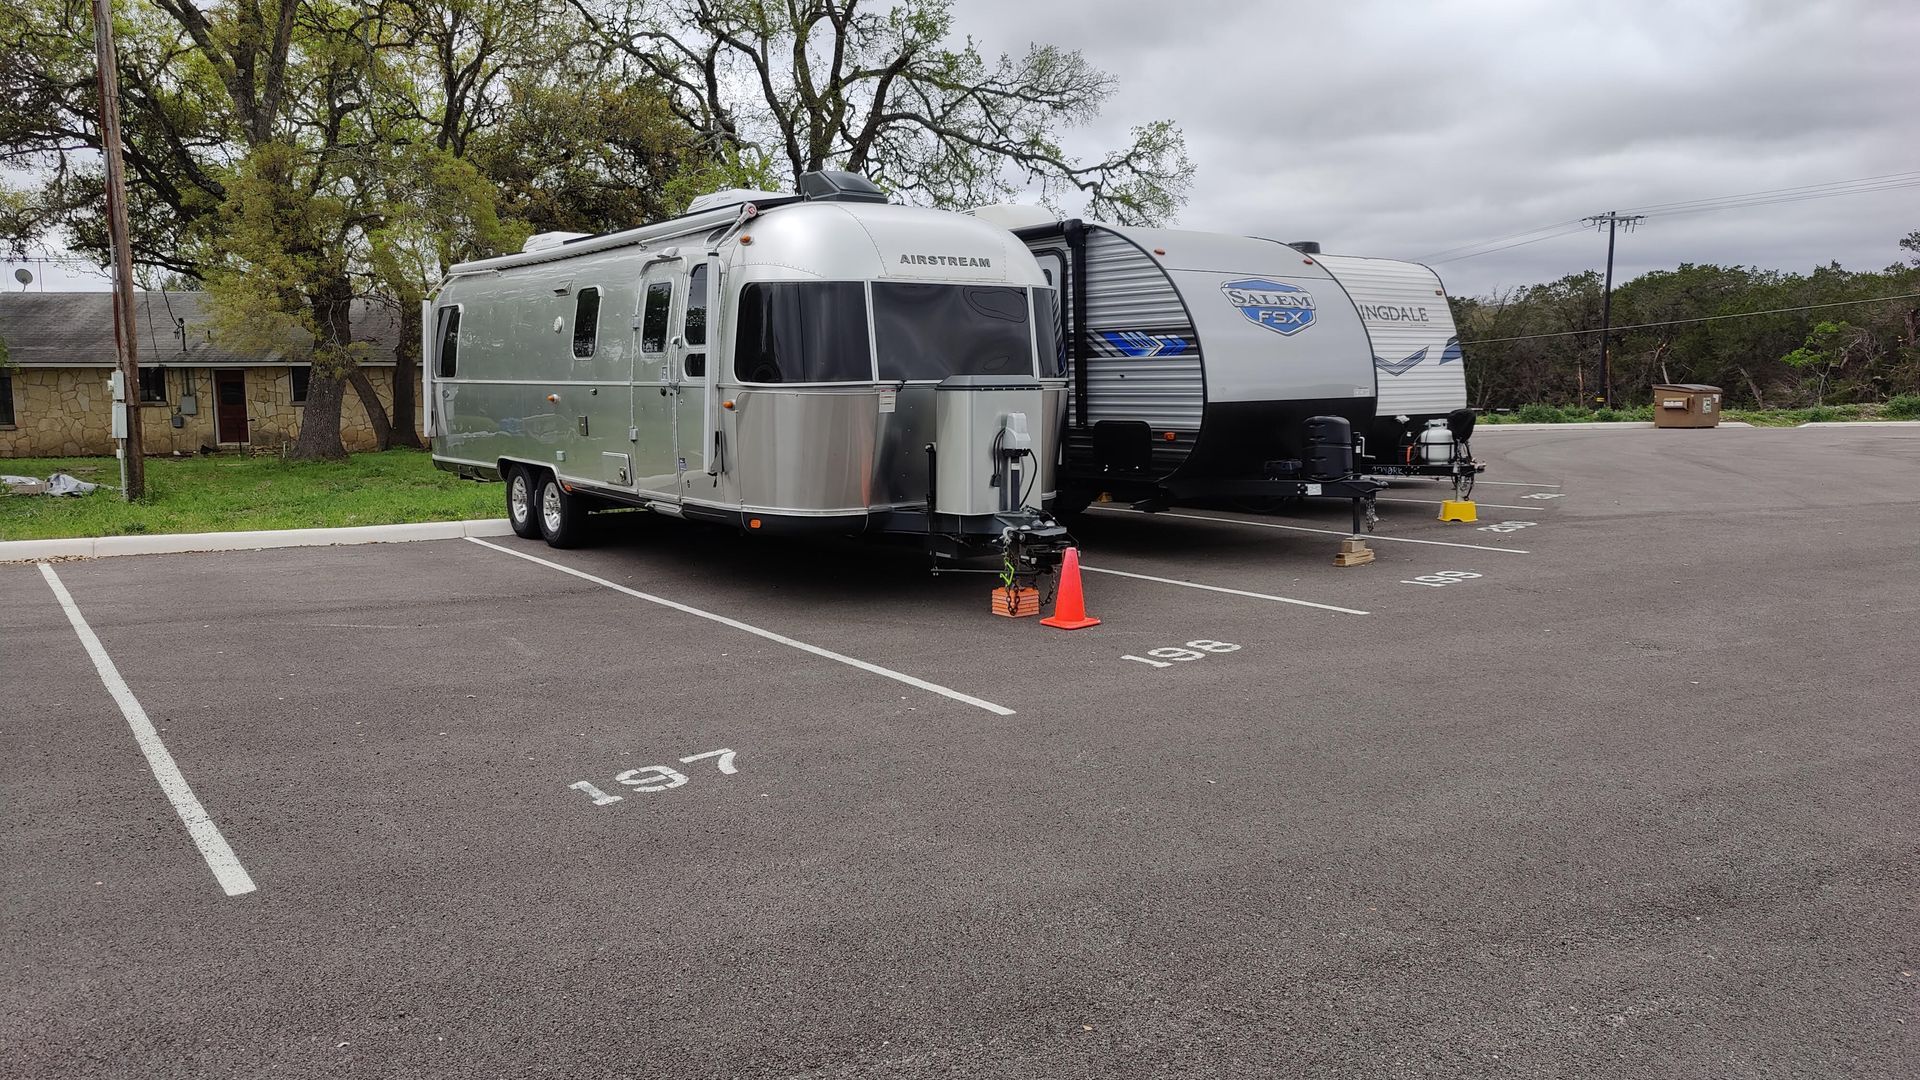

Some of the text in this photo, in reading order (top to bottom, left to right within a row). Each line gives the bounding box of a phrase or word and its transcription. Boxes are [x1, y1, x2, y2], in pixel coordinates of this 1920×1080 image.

[900, 254, 991, 268] AIRSTREAM
[1228, 290, 1314, 307] SALEM
[1258, 311, 1304, 324] FSX
[1360, 304, 1429, 322] INGDALE
[1400, 570, 1483, 587] 199
[1120, 639, 1242, 668] 198
[568, 747, 739, 806] 197
